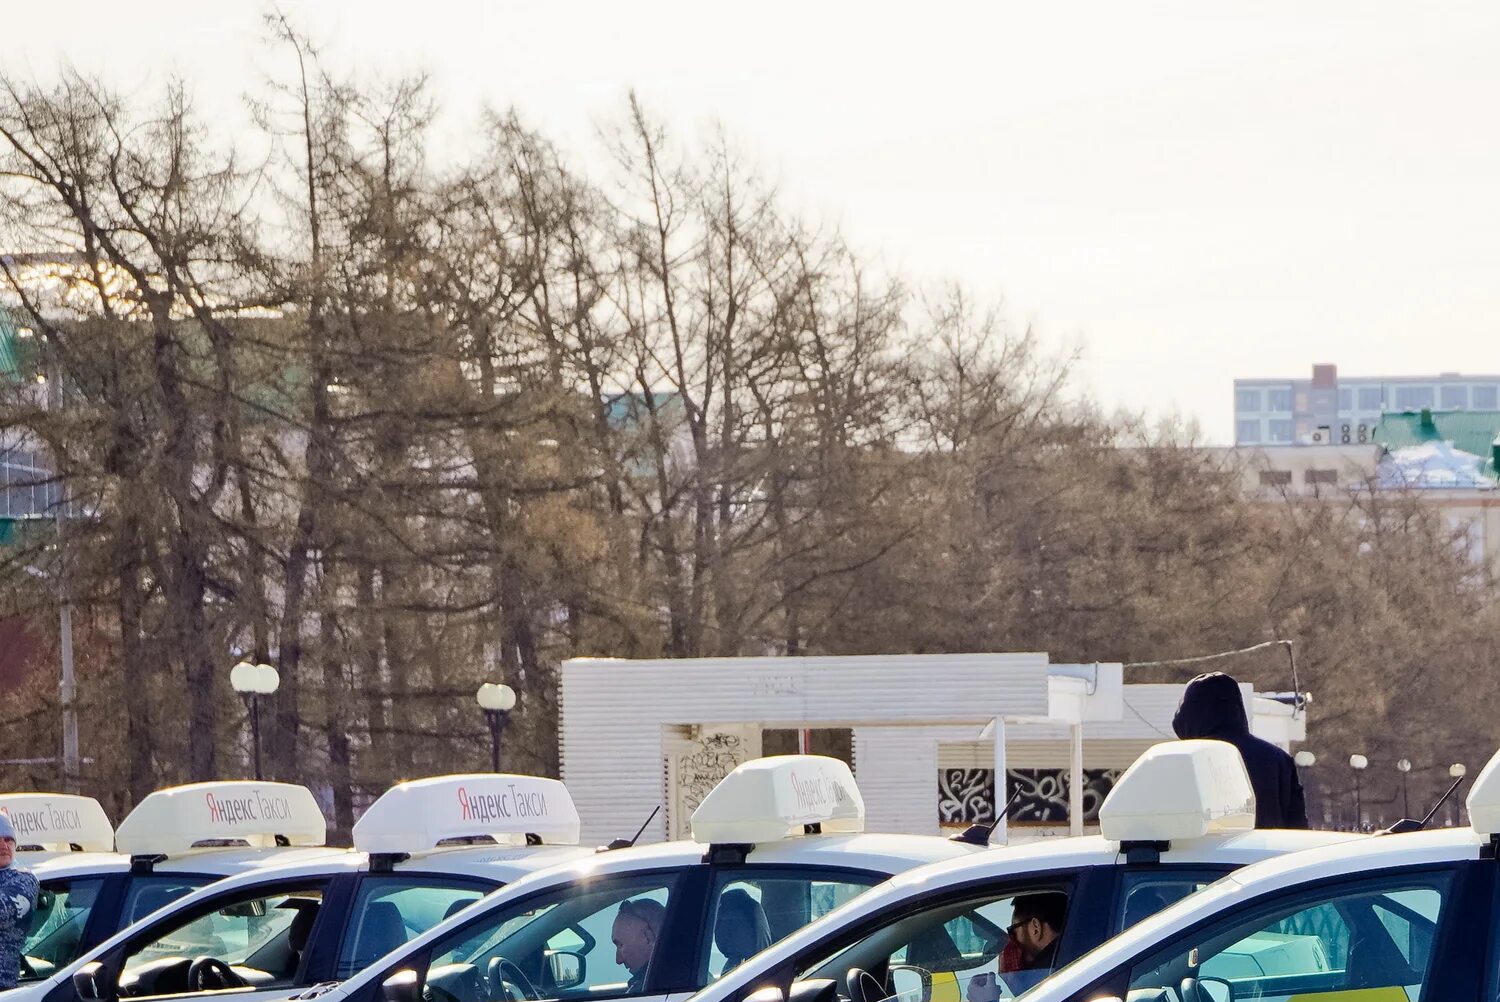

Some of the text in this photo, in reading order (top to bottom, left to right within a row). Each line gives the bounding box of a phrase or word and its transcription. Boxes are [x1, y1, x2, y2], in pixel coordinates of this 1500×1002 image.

[45, 803, 82, 830] Такси
[206, 789, 292, 826] Яндекс Такси
[458, 784, 548, 823] Яндекс Такси
